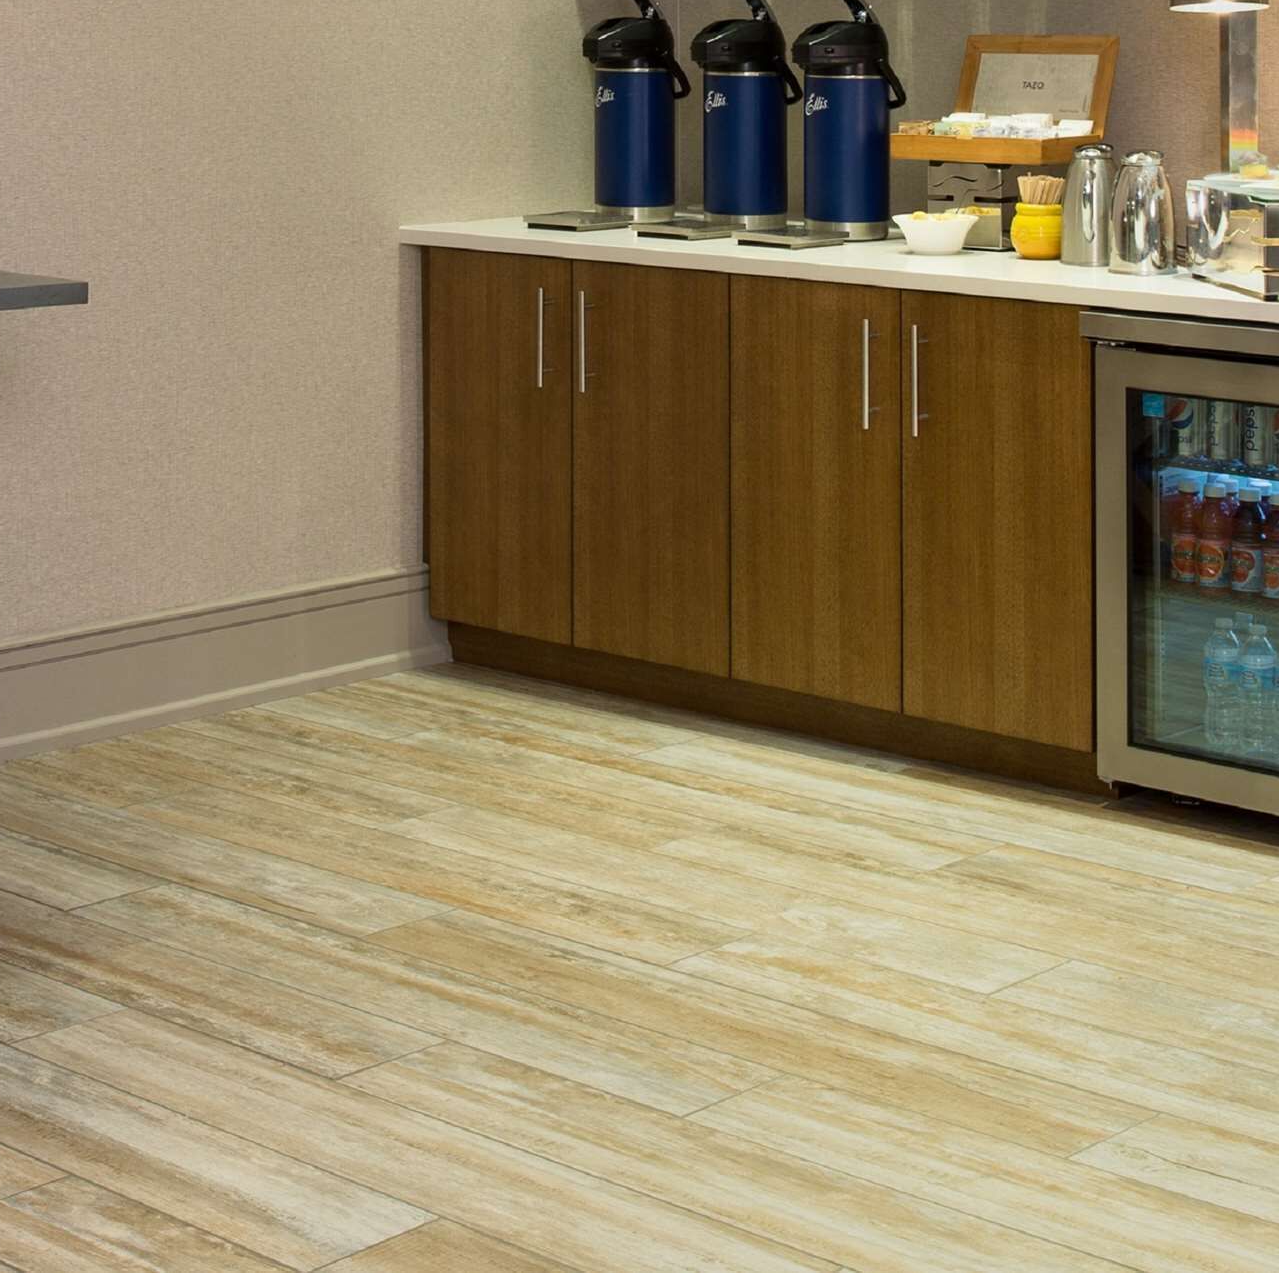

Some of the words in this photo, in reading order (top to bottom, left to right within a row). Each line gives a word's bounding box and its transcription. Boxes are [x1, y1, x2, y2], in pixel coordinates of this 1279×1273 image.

[1022, 80, 1045, 90] TAZO
[596, 86, 615, 108] Ellis
[705, 90, 726, 113] Ellis
[805, 93, 827, 116] Ellis
[1245, 406, 1259, 452] peps
